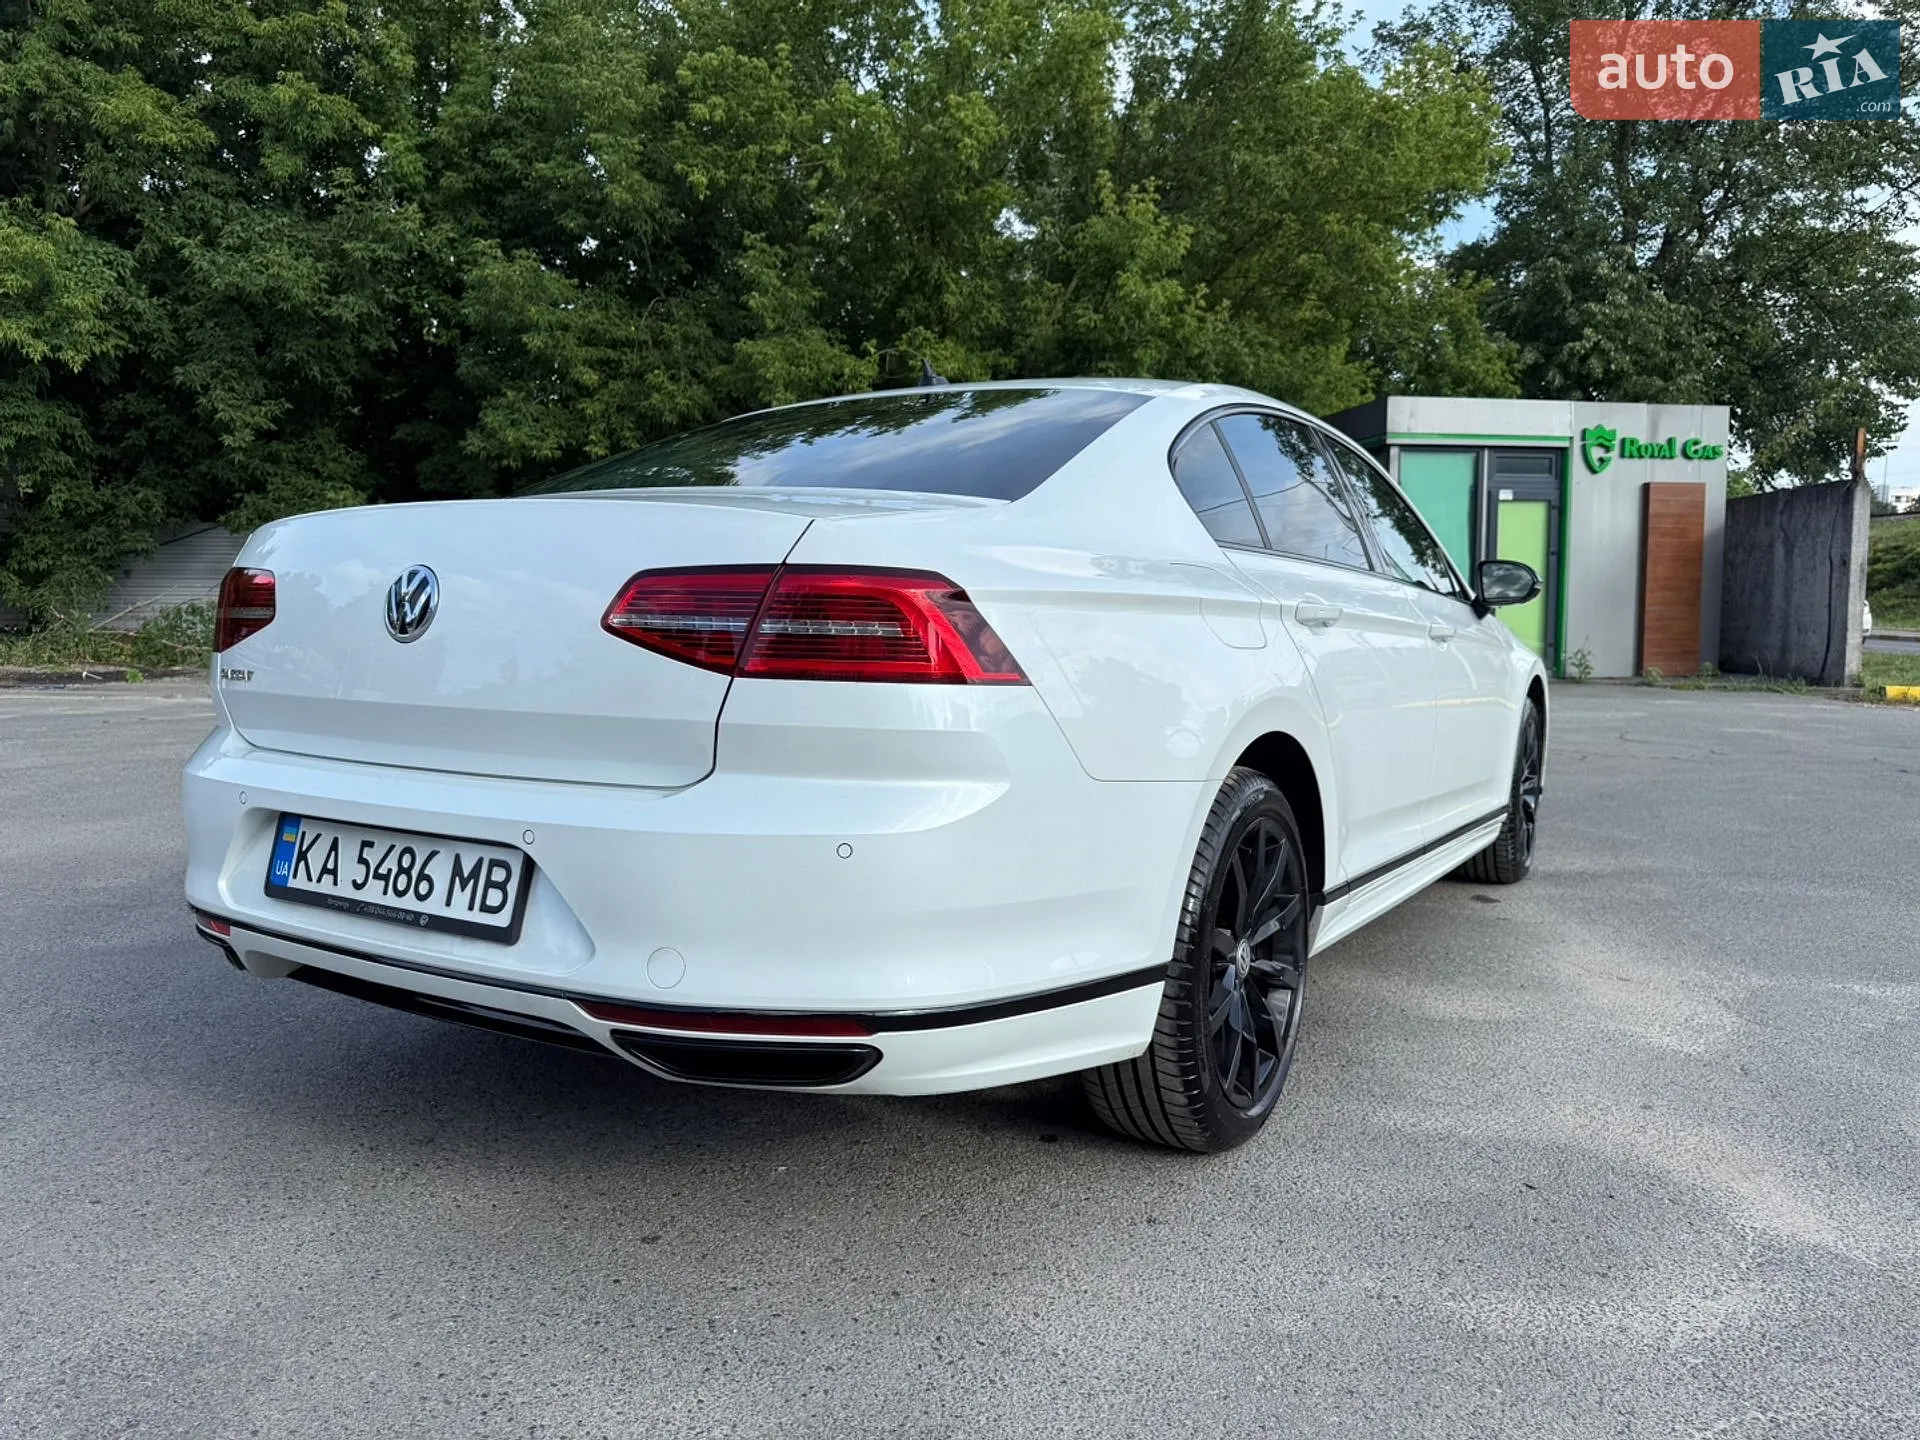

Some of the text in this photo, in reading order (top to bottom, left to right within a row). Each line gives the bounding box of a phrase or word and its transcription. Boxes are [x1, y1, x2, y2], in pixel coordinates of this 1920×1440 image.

[275, 861, 289, 876] UA
[292, 830, 513, 915] KA 5486 MB
